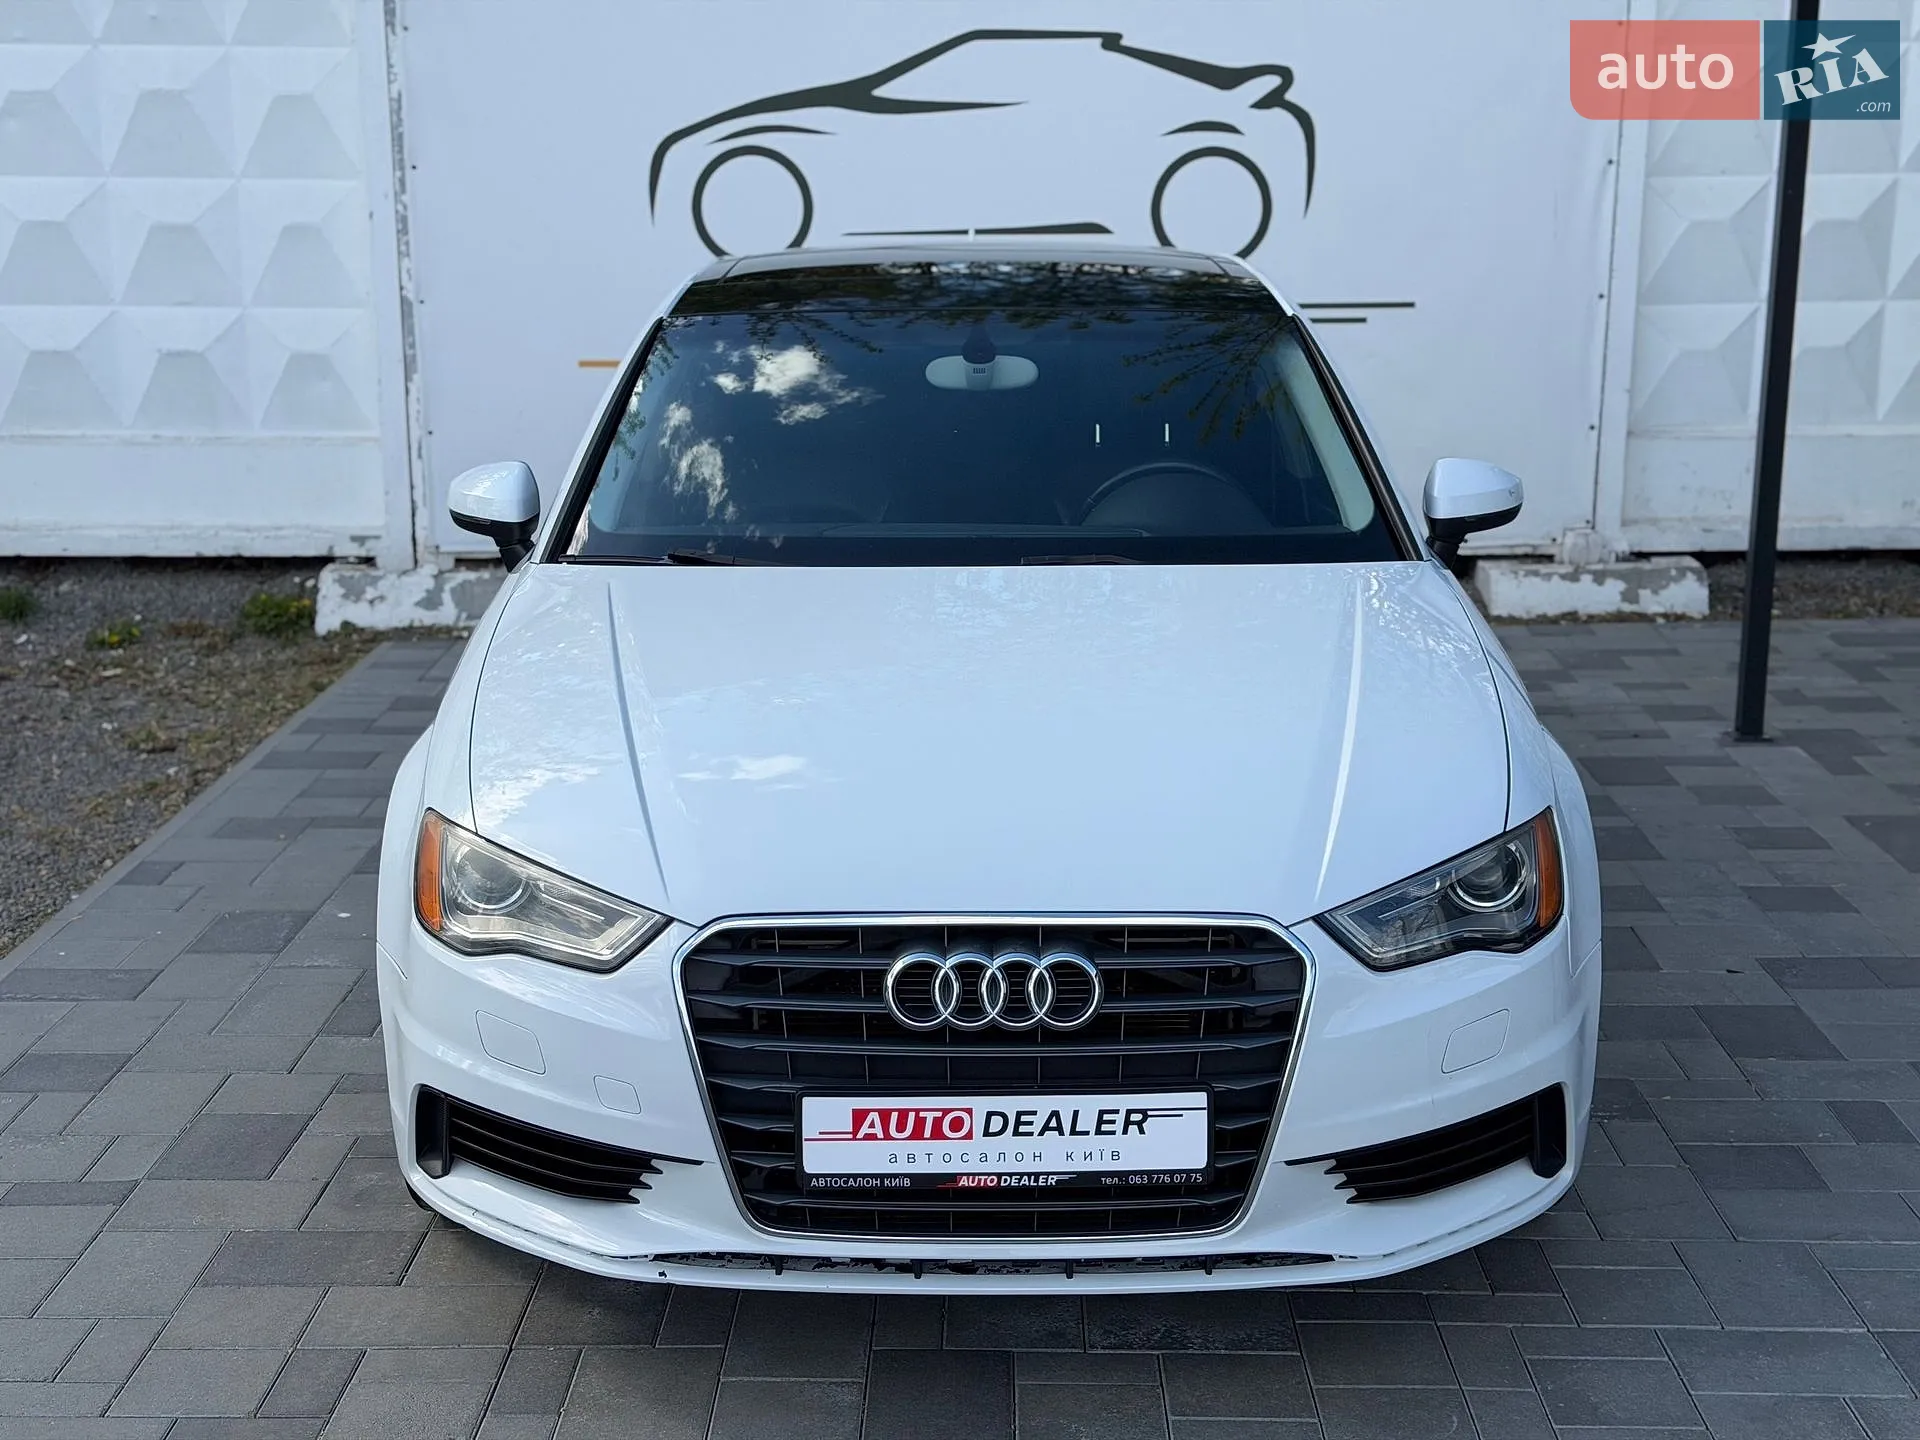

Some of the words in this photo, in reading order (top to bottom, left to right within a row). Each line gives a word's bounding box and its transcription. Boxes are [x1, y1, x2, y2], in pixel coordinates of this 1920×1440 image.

[857, 1110, 970, 1140] AUTO
[982, 1109, 1147, 1138] DEALER
[888, 1151, 1043, 1164] автосалон
[1065, 1148, 1122, 1162] київ
[810, 1177, 881, 1188] АВТОСАЛОН
[884, 1175, 911, 1187] КИЇВ
[958, 1175, 998, 1187] AUTO
[1000, 1175, 1057, 1186] DEALER
[1101, 1177, 1126, 1185] тел.:
[1128, 1174, 1149, 1184] 063
[1151, 1173, 1172, 1184] 776
[1173, 1173, 1187, 1183] 07
[1190, 1173, 1203, 1183] 75
